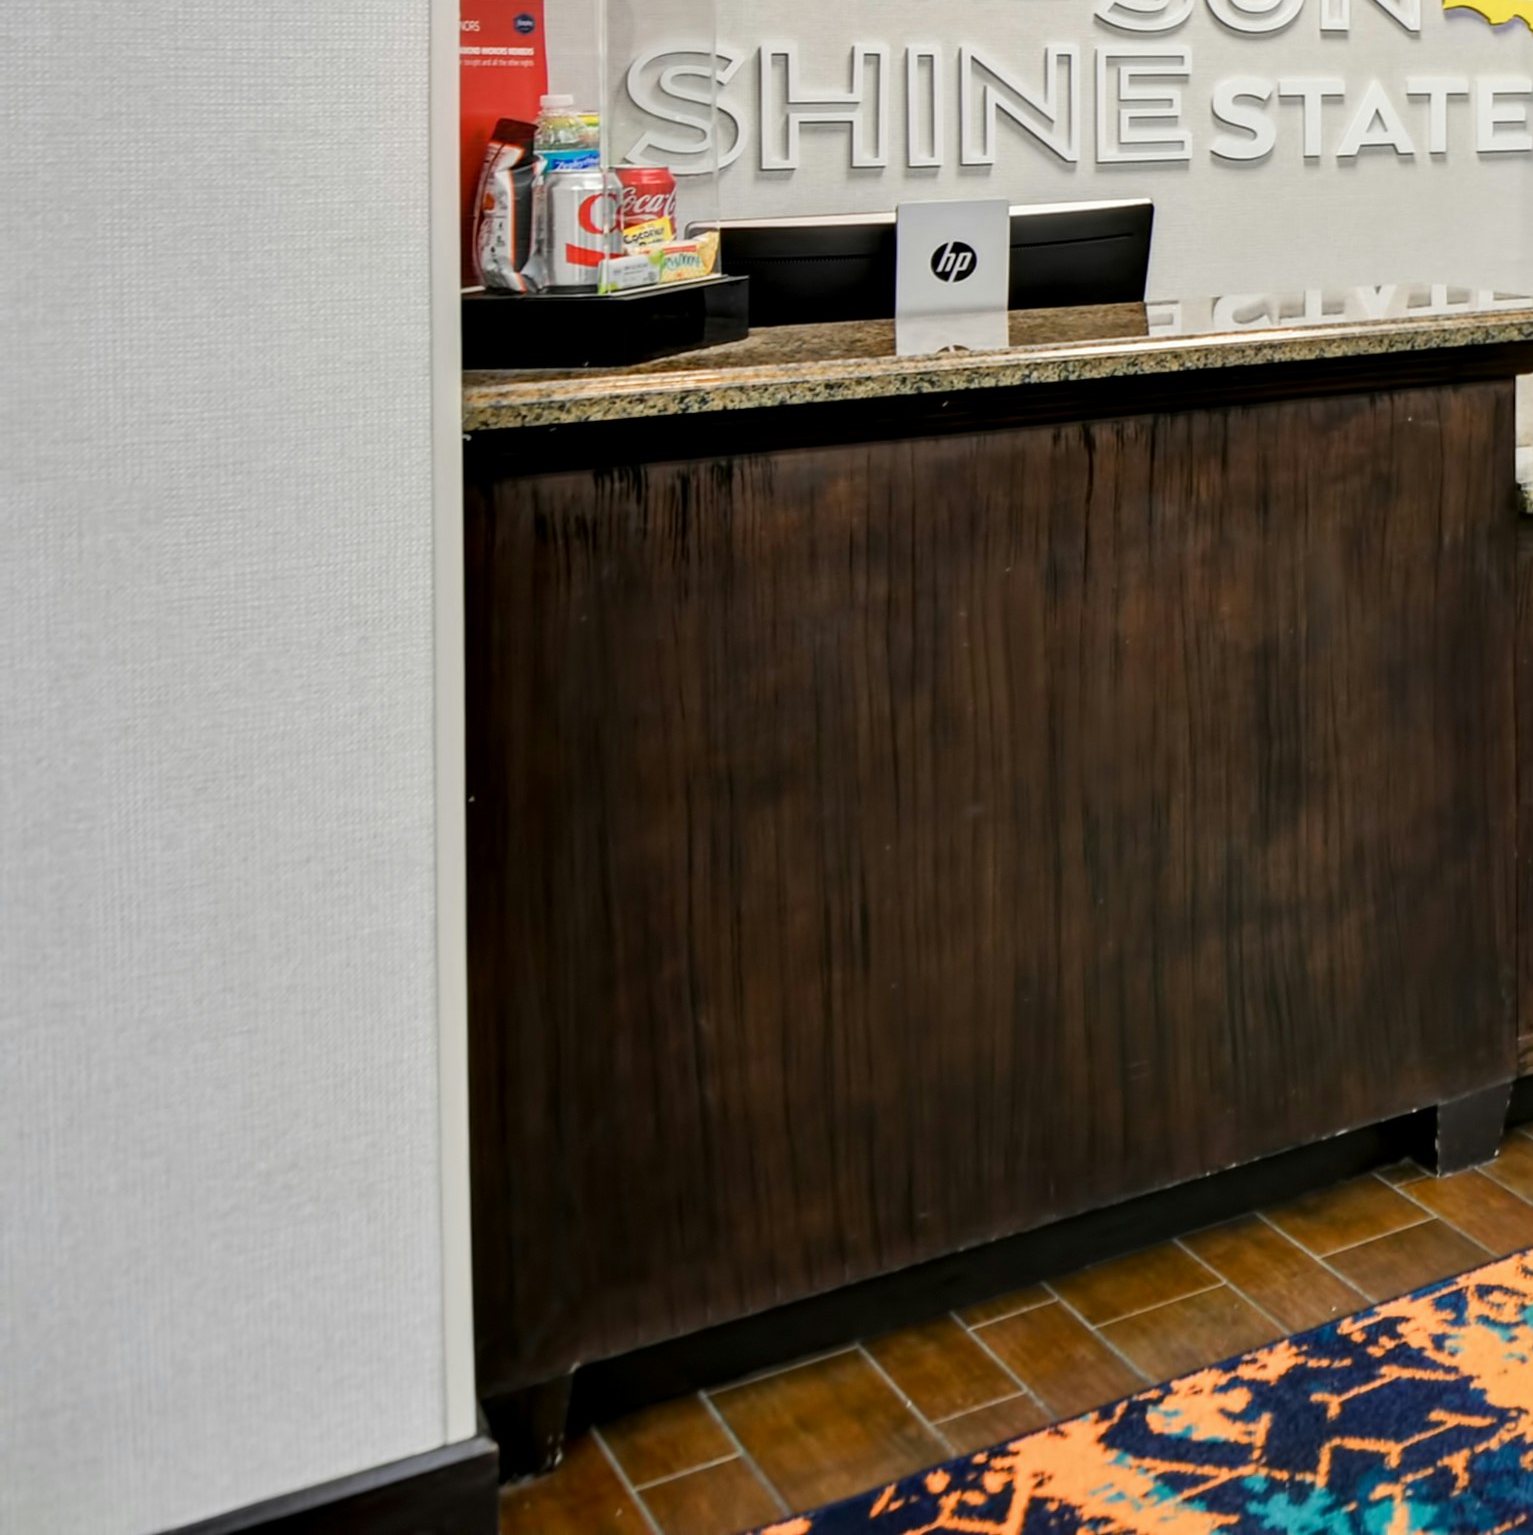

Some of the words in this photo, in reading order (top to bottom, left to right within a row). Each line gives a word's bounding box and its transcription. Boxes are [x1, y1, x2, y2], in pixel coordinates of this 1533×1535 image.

[624, 42, 1194, 176] SHINE
[1209, 77, 1533, 161] STATE
[933, 240, 976, 283] hp
